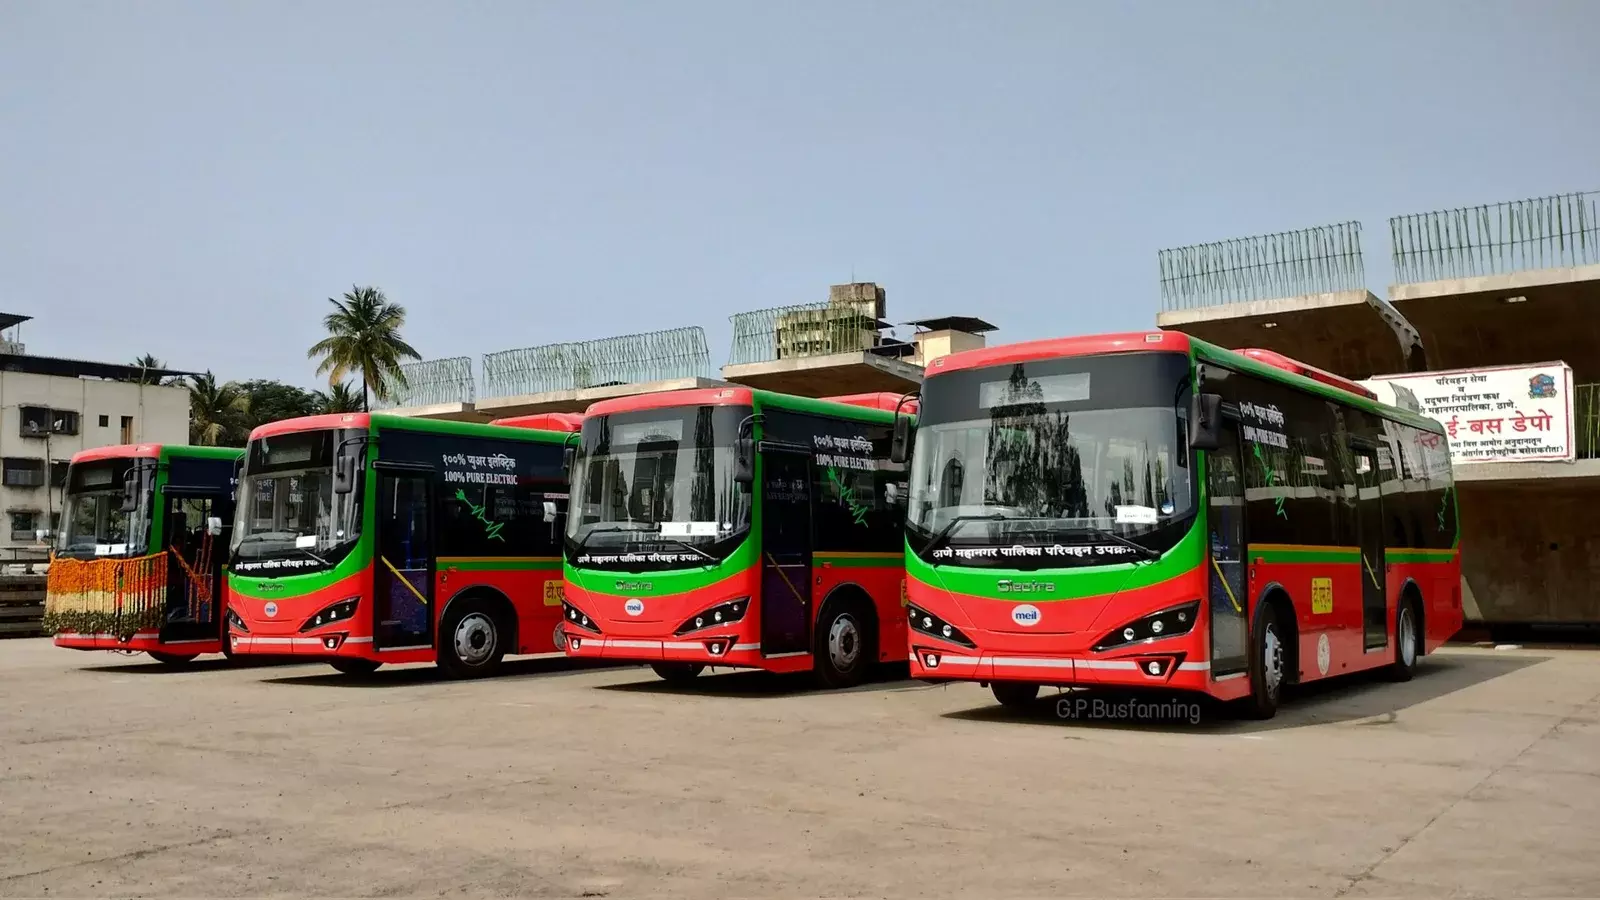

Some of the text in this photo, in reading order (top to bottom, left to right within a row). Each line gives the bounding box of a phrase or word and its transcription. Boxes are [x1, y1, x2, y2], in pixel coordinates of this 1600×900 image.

[1435, 373, 1487, 385] परिवहन सेवा
[1424, 396, 1449, 406] प्रदूषण
[1451, 393, 1480, 402] नियंत्रण
[1445, 408, 1553, 439] ई-बस डेपो
[466, 455, 487, 470] प्युअर
[487, 453, 516, 471] इलेक्ट्रिक
[816, 453, 876, 471] 100% PURE ELECTRIC
[444, 470, 518, 485] 100% PURE ELECTRIC
[591, 555, 618, 564] महानगर
[619, 553, 646, 562] पालिका
[647, 552, 678, 563] परिवहन
[932, 547, 953, 559] ठाणे
[955, 547, 998, 560] महानगर
[1000, 545, 1042, 557] पालिका
[1044, 544, 1092, 558] परिवहन
[1015, 610, 1037, 620] meil
